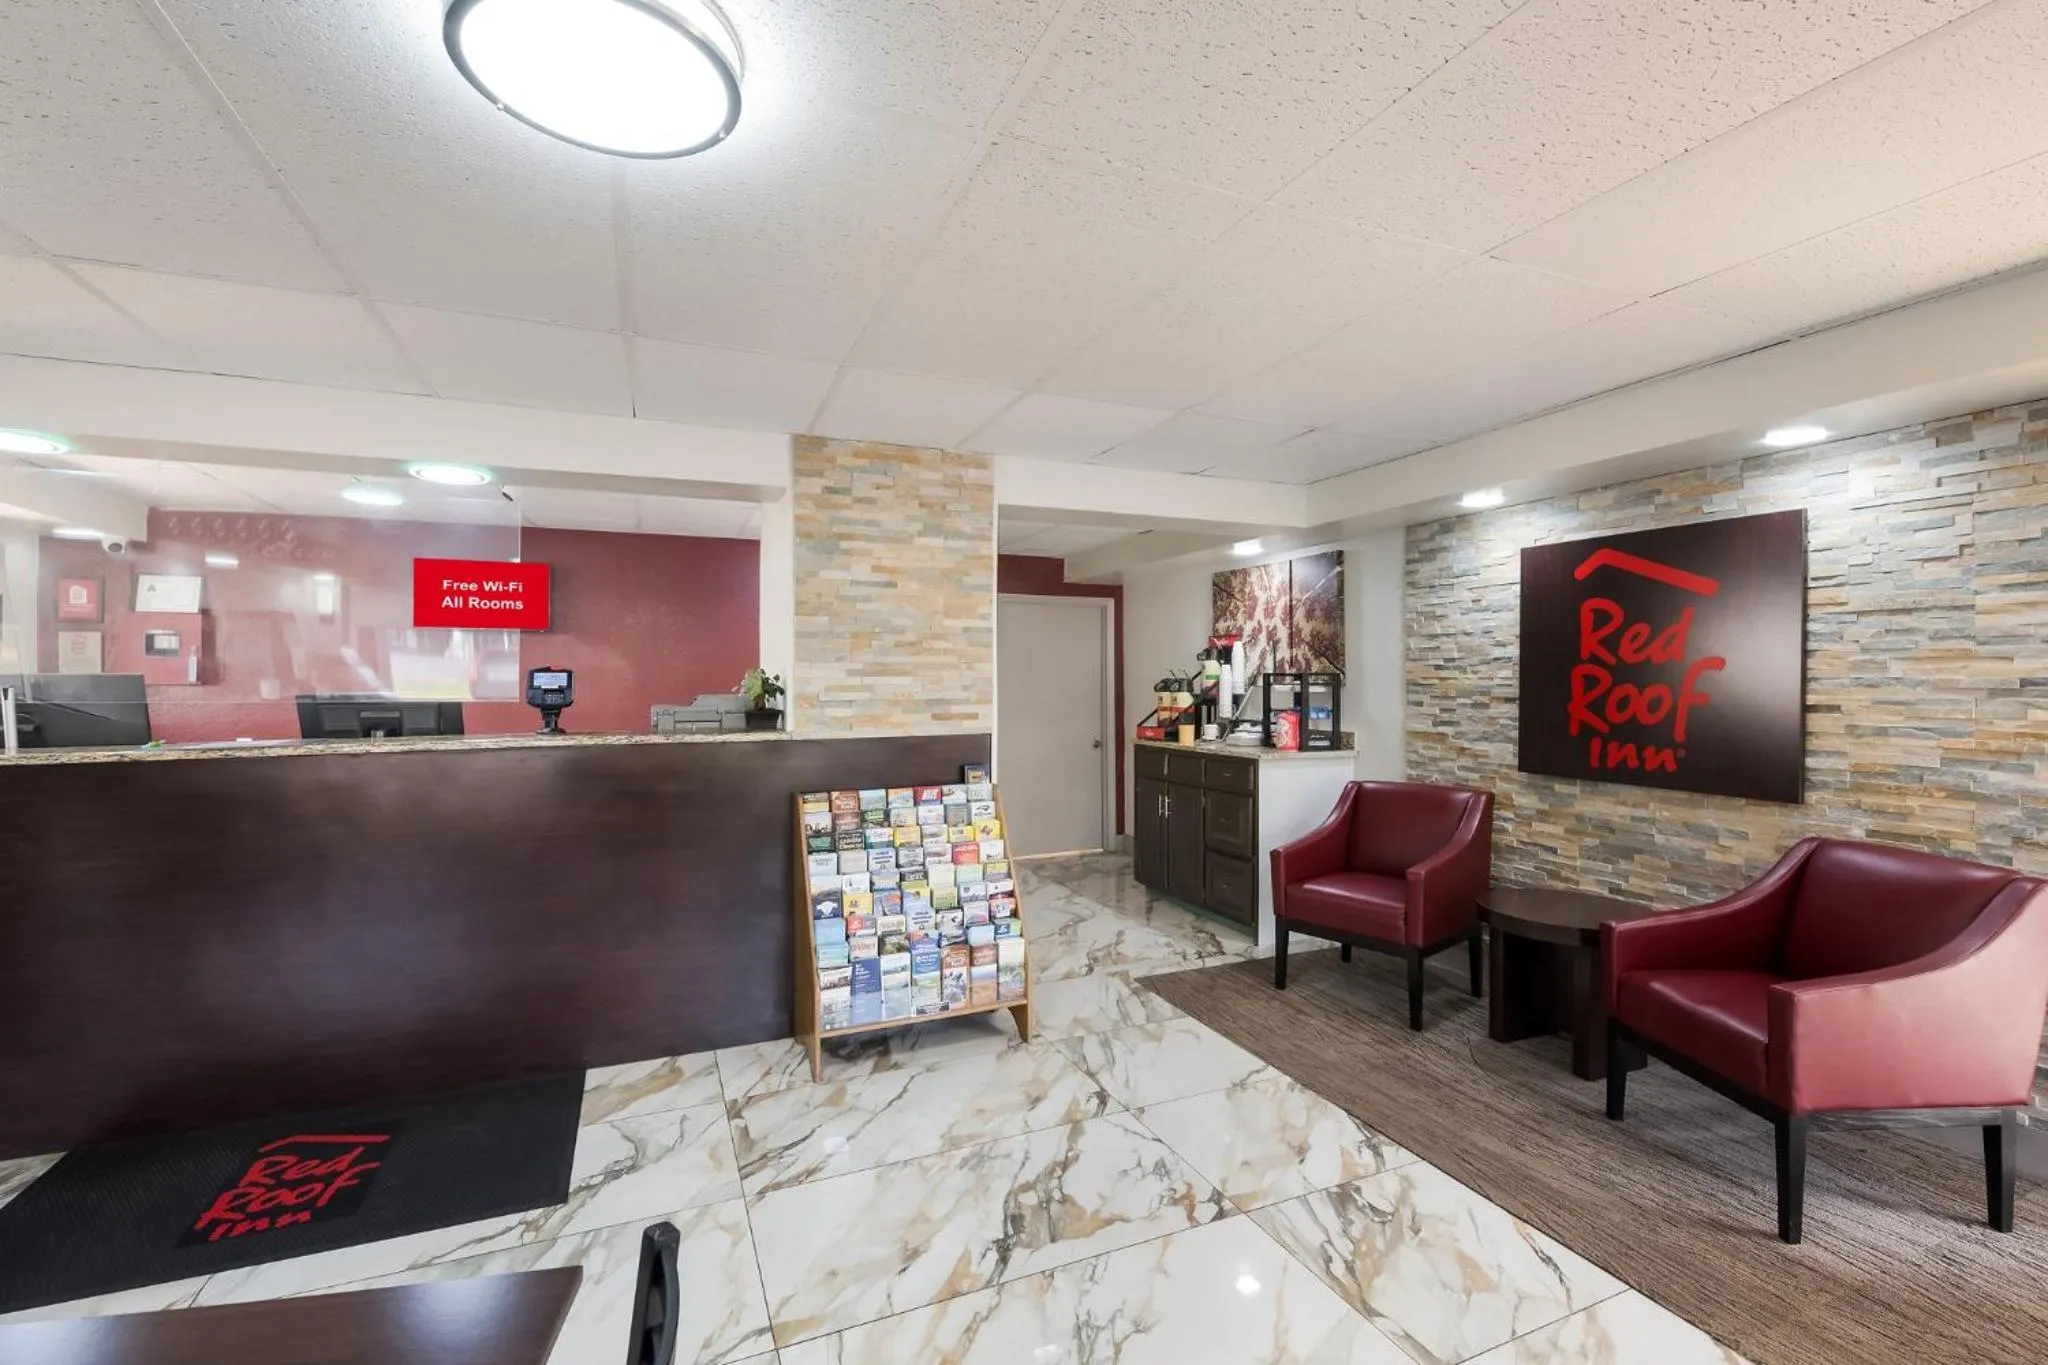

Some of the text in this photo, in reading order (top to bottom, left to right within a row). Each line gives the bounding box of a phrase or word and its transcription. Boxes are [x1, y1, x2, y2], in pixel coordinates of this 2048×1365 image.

[441, 596, 524, 610] All Rooms
[442, 579, 523, 593] Free Wi-Fi
[1579, 597, 1695, 666] Red
[1567, 656, 1726, 743] Roof
[1589, 736, 1679, 772] Inn
[238, 1145, 365, 1187] Red
[193, 1161, 381, 1230] Roof
[208, 1210, 312, 1243] Inn
